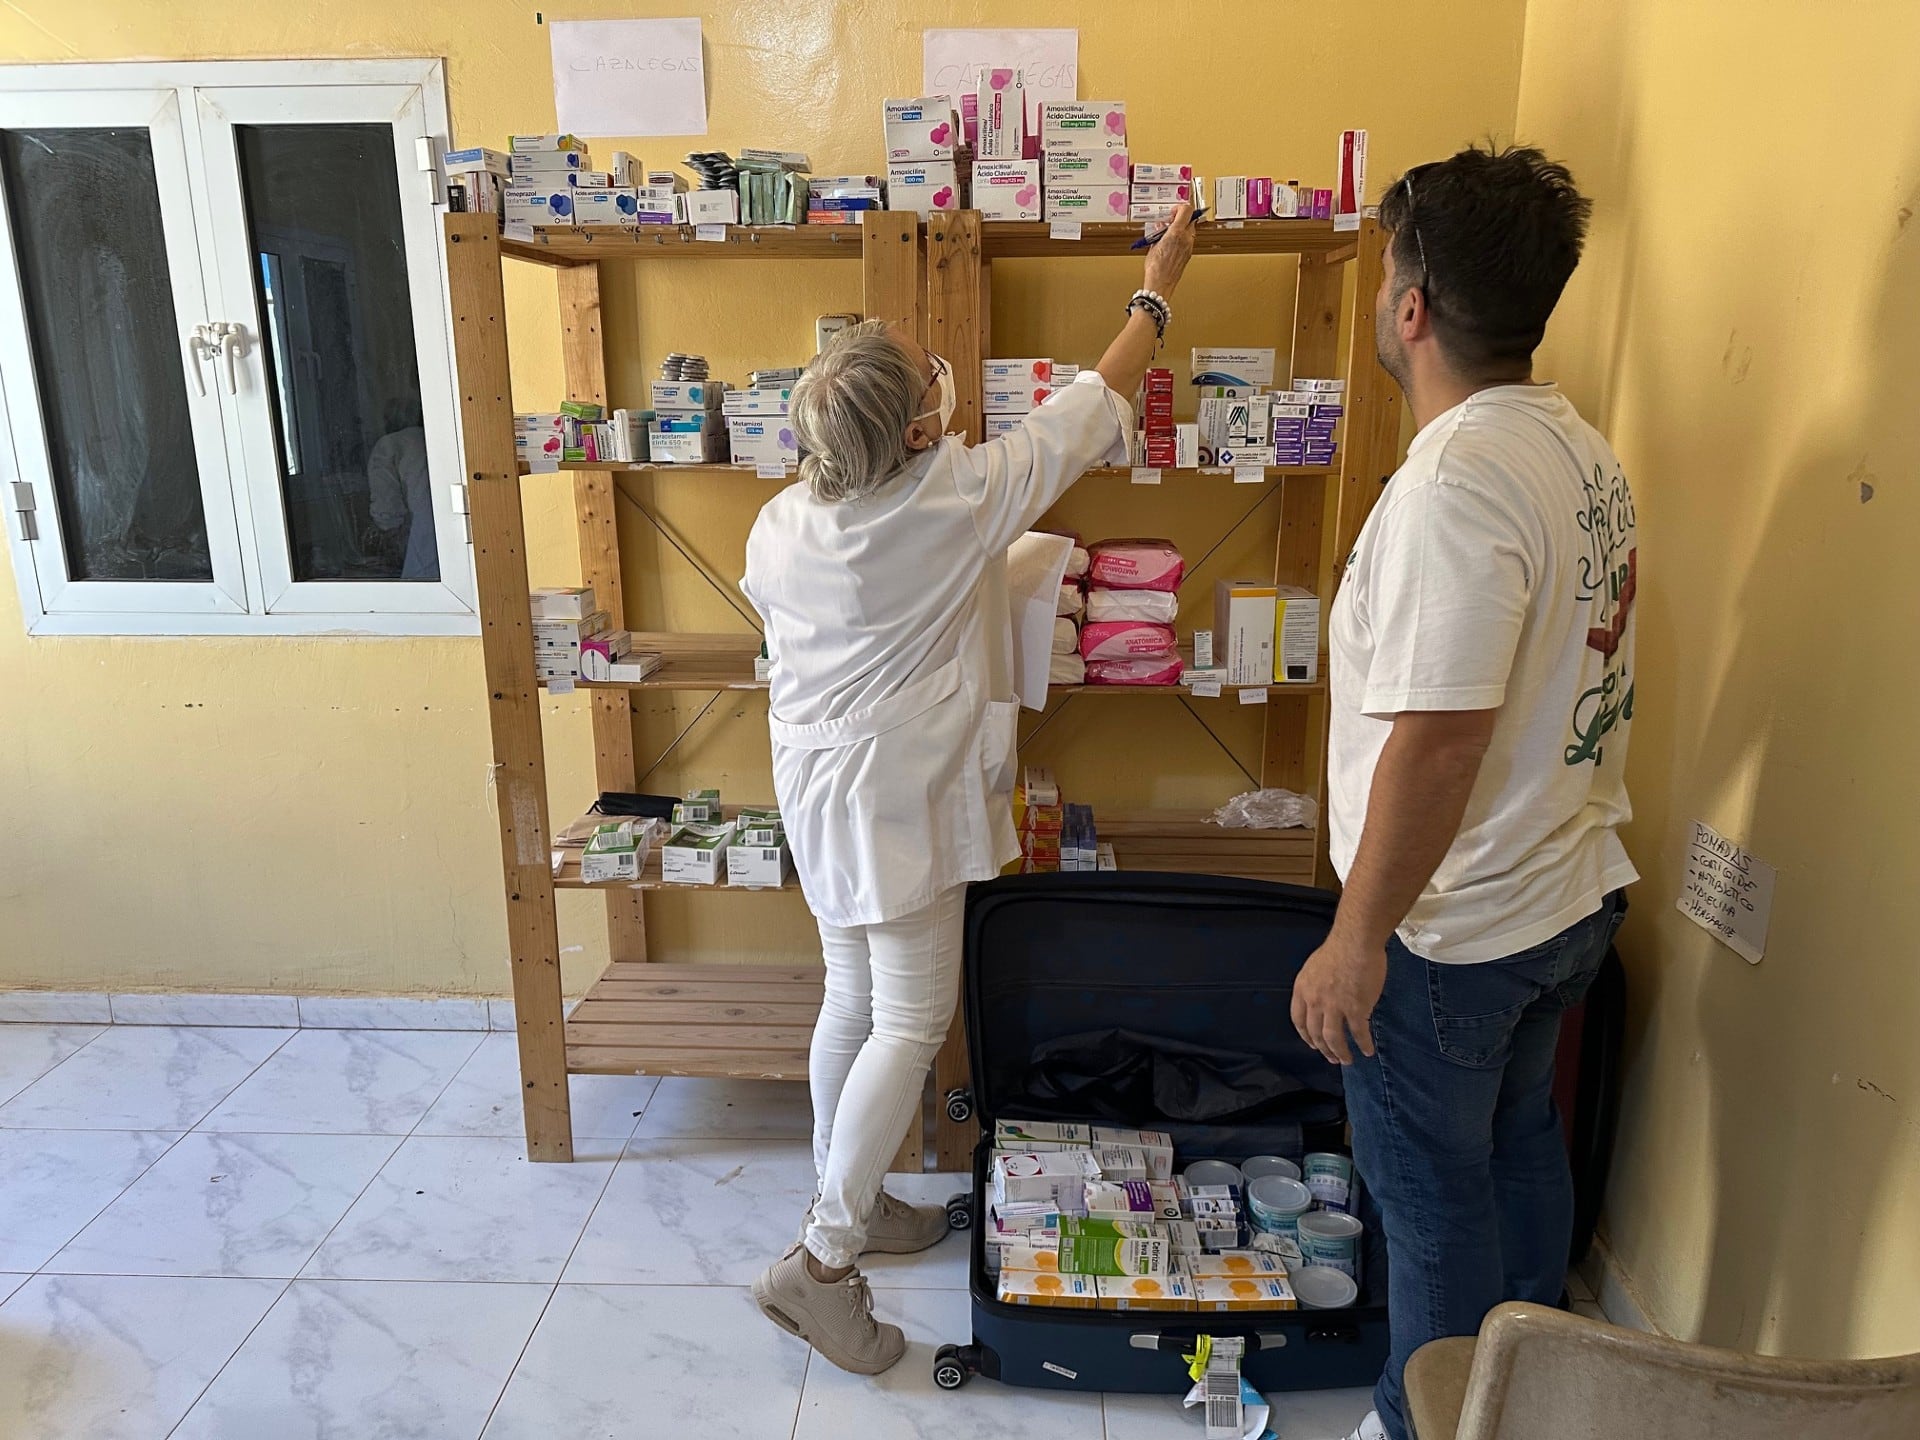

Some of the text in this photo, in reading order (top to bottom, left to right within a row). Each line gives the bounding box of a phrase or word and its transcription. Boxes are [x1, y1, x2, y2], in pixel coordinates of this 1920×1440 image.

[1696, 824, 1752, 871] POMADAS
[1141, 1242, 1149, 1255] Teva
[1152, 1242, 1160, 1271] Cetirizina
